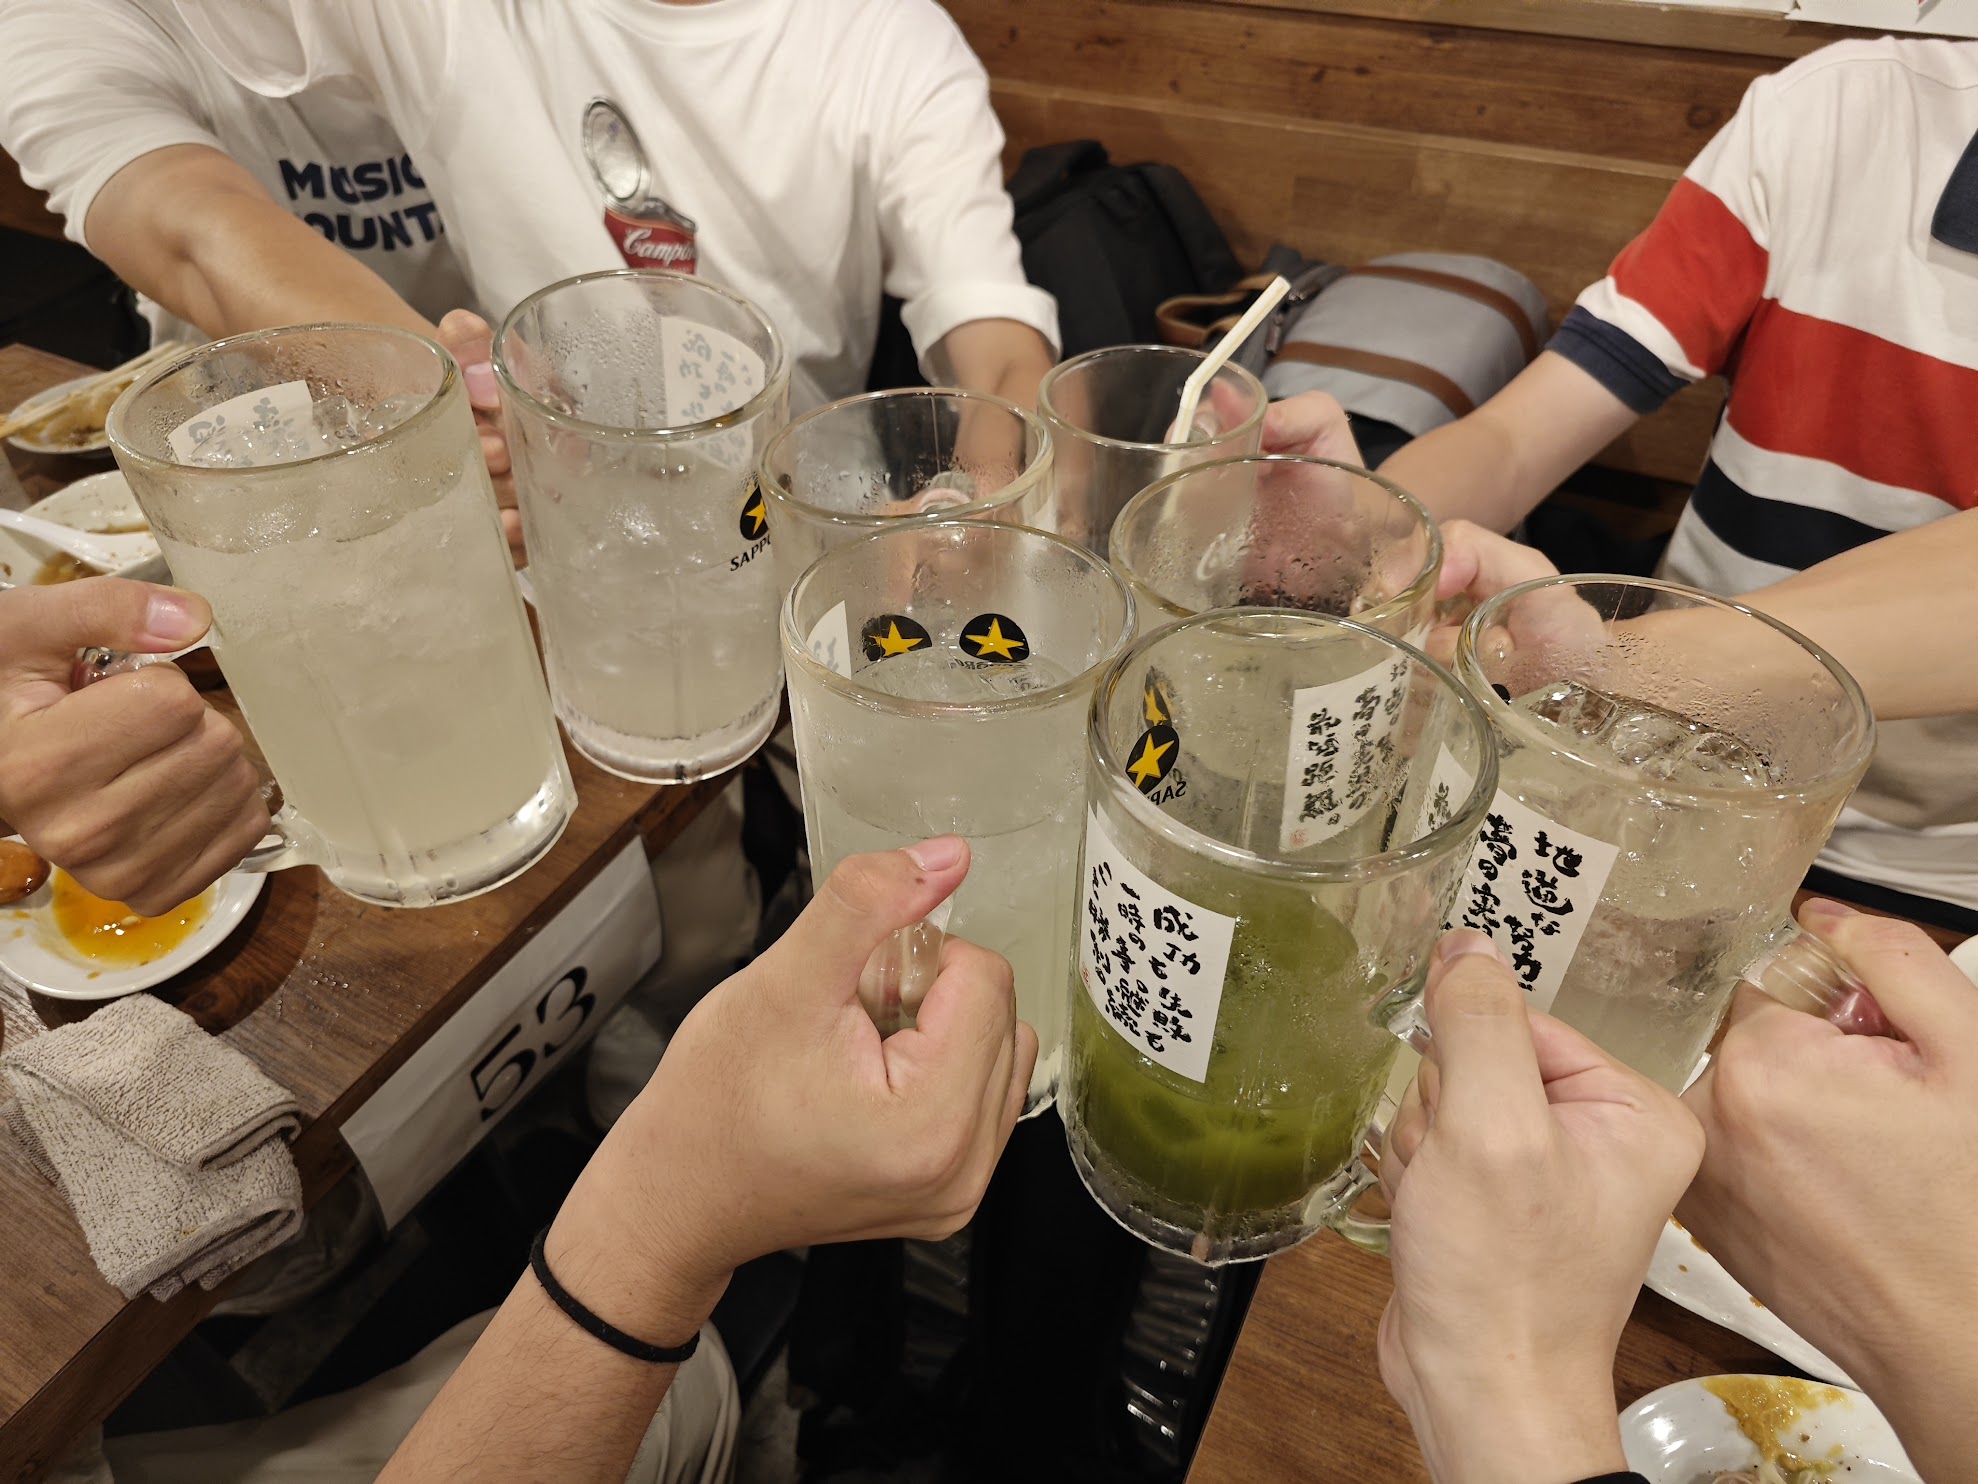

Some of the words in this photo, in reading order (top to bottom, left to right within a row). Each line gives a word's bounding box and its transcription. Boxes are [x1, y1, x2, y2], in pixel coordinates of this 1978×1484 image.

[278, 153, 426, 205] MUSIC
[304, 202, 444, 251] OUNT
[1145, 904, 1200, 1052] 成功も失敗も
[1502, 829, 1584, 992] 地道な努力
[470, 966, 596, 1123] 53
